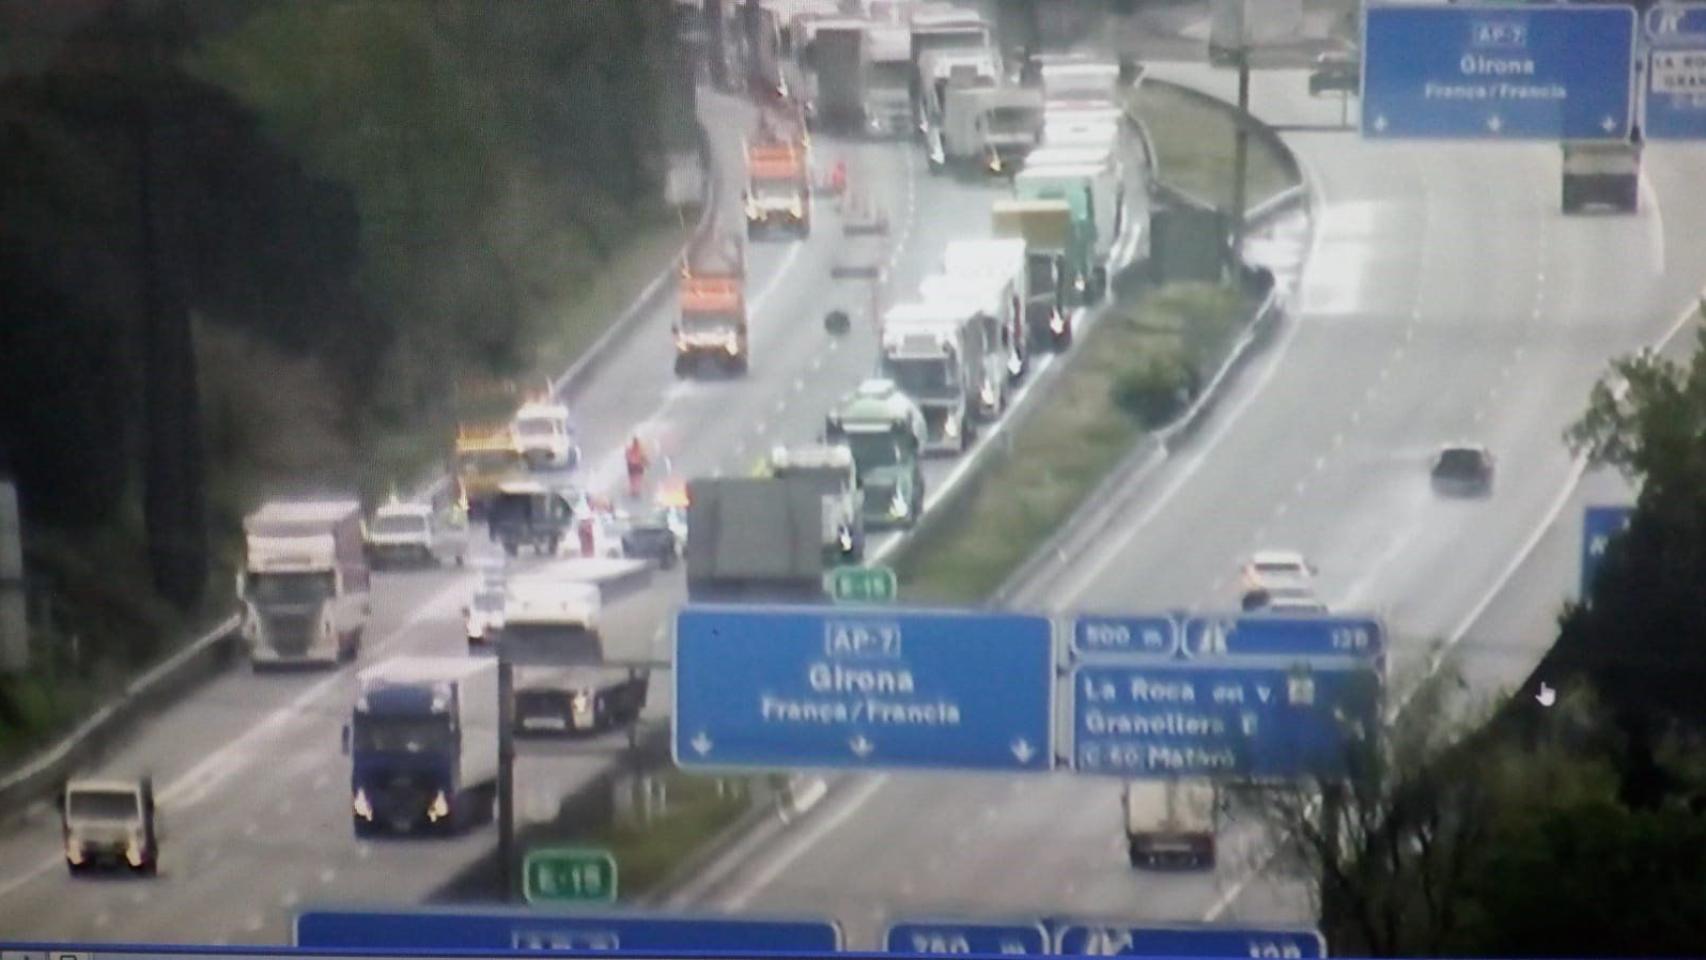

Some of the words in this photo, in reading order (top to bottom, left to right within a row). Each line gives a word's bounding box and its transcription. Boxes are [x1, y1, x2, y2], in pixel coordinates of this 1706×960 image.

[1460, 54, 1536, 75] Girona
[833, 626, 896, 653] AP-7
[1143, 630, 1164, 648] m
[809, 661, 915, 693] Girona
[1083, 676, 1117, 702] La
[1131, 676, 1196, 702] Roca
[1084, 709, 1226, 735] Granollers
